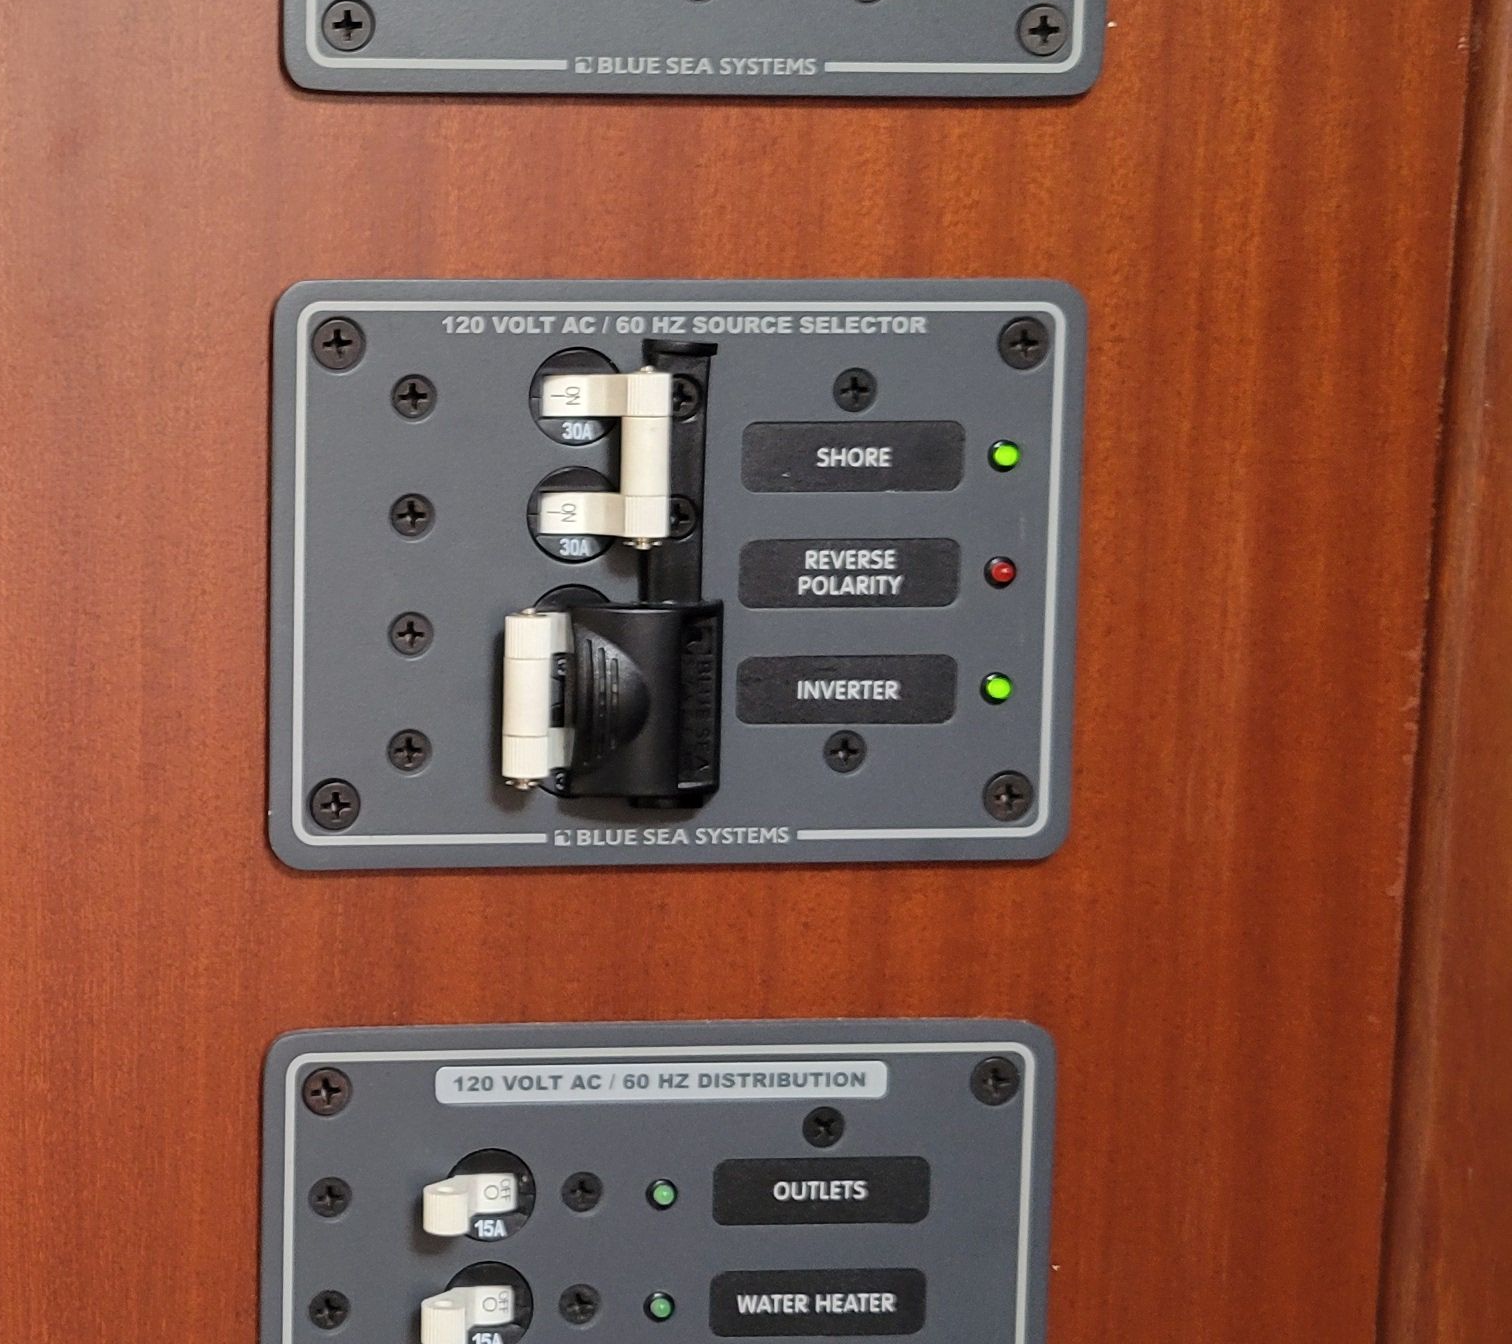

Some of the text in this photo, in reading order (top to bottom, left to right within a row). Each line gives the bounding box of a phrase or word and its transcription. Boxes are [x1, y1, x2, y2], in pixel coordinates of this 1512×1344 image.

[598, 57, 816, 75] BLUE SEA SYSTEMS
[442, 316, 484, 333] 120
[492, 316, 556, 333] VOLT
[562, 317, 595, 333] AC
[616, 316, 645, 333] 60
[653, 317, 686, 333] HZ
[693, 317, 792, 333] SOURCE
[800, 317, 926, 333] SELECTOR
[565, 386, 581, 406] ON
[562, 422, 591, 440] 30A
[817, 448, 890, 467] SHORE
[562, 503, 576, 523] ON
[560, 537, 592, 556] 30A
[805, 550, 895, 569] REVERSE
[798, 576, 902, 595] POLARITY
[798, 680, 898, 700] INVERTER
[577, 827, 790, 845] BLUE SEA SYSTEMS
[455, 1076, 493, 1091] 120
[503, 1075, 563, 1091] VOLT
[571, 1075, 601, 1089] AC
[623, 1074, 649, 1089] 60
[659, 1074, 689, 1088] HZ
[698, 1072, 865, 1088] DISTRIBUTION
[774, 1181, 866, 1200] OUTLETS
[475, 1220, 506, 1237] 15A
[738, 1293, 895, 1313] WATER HEATER
